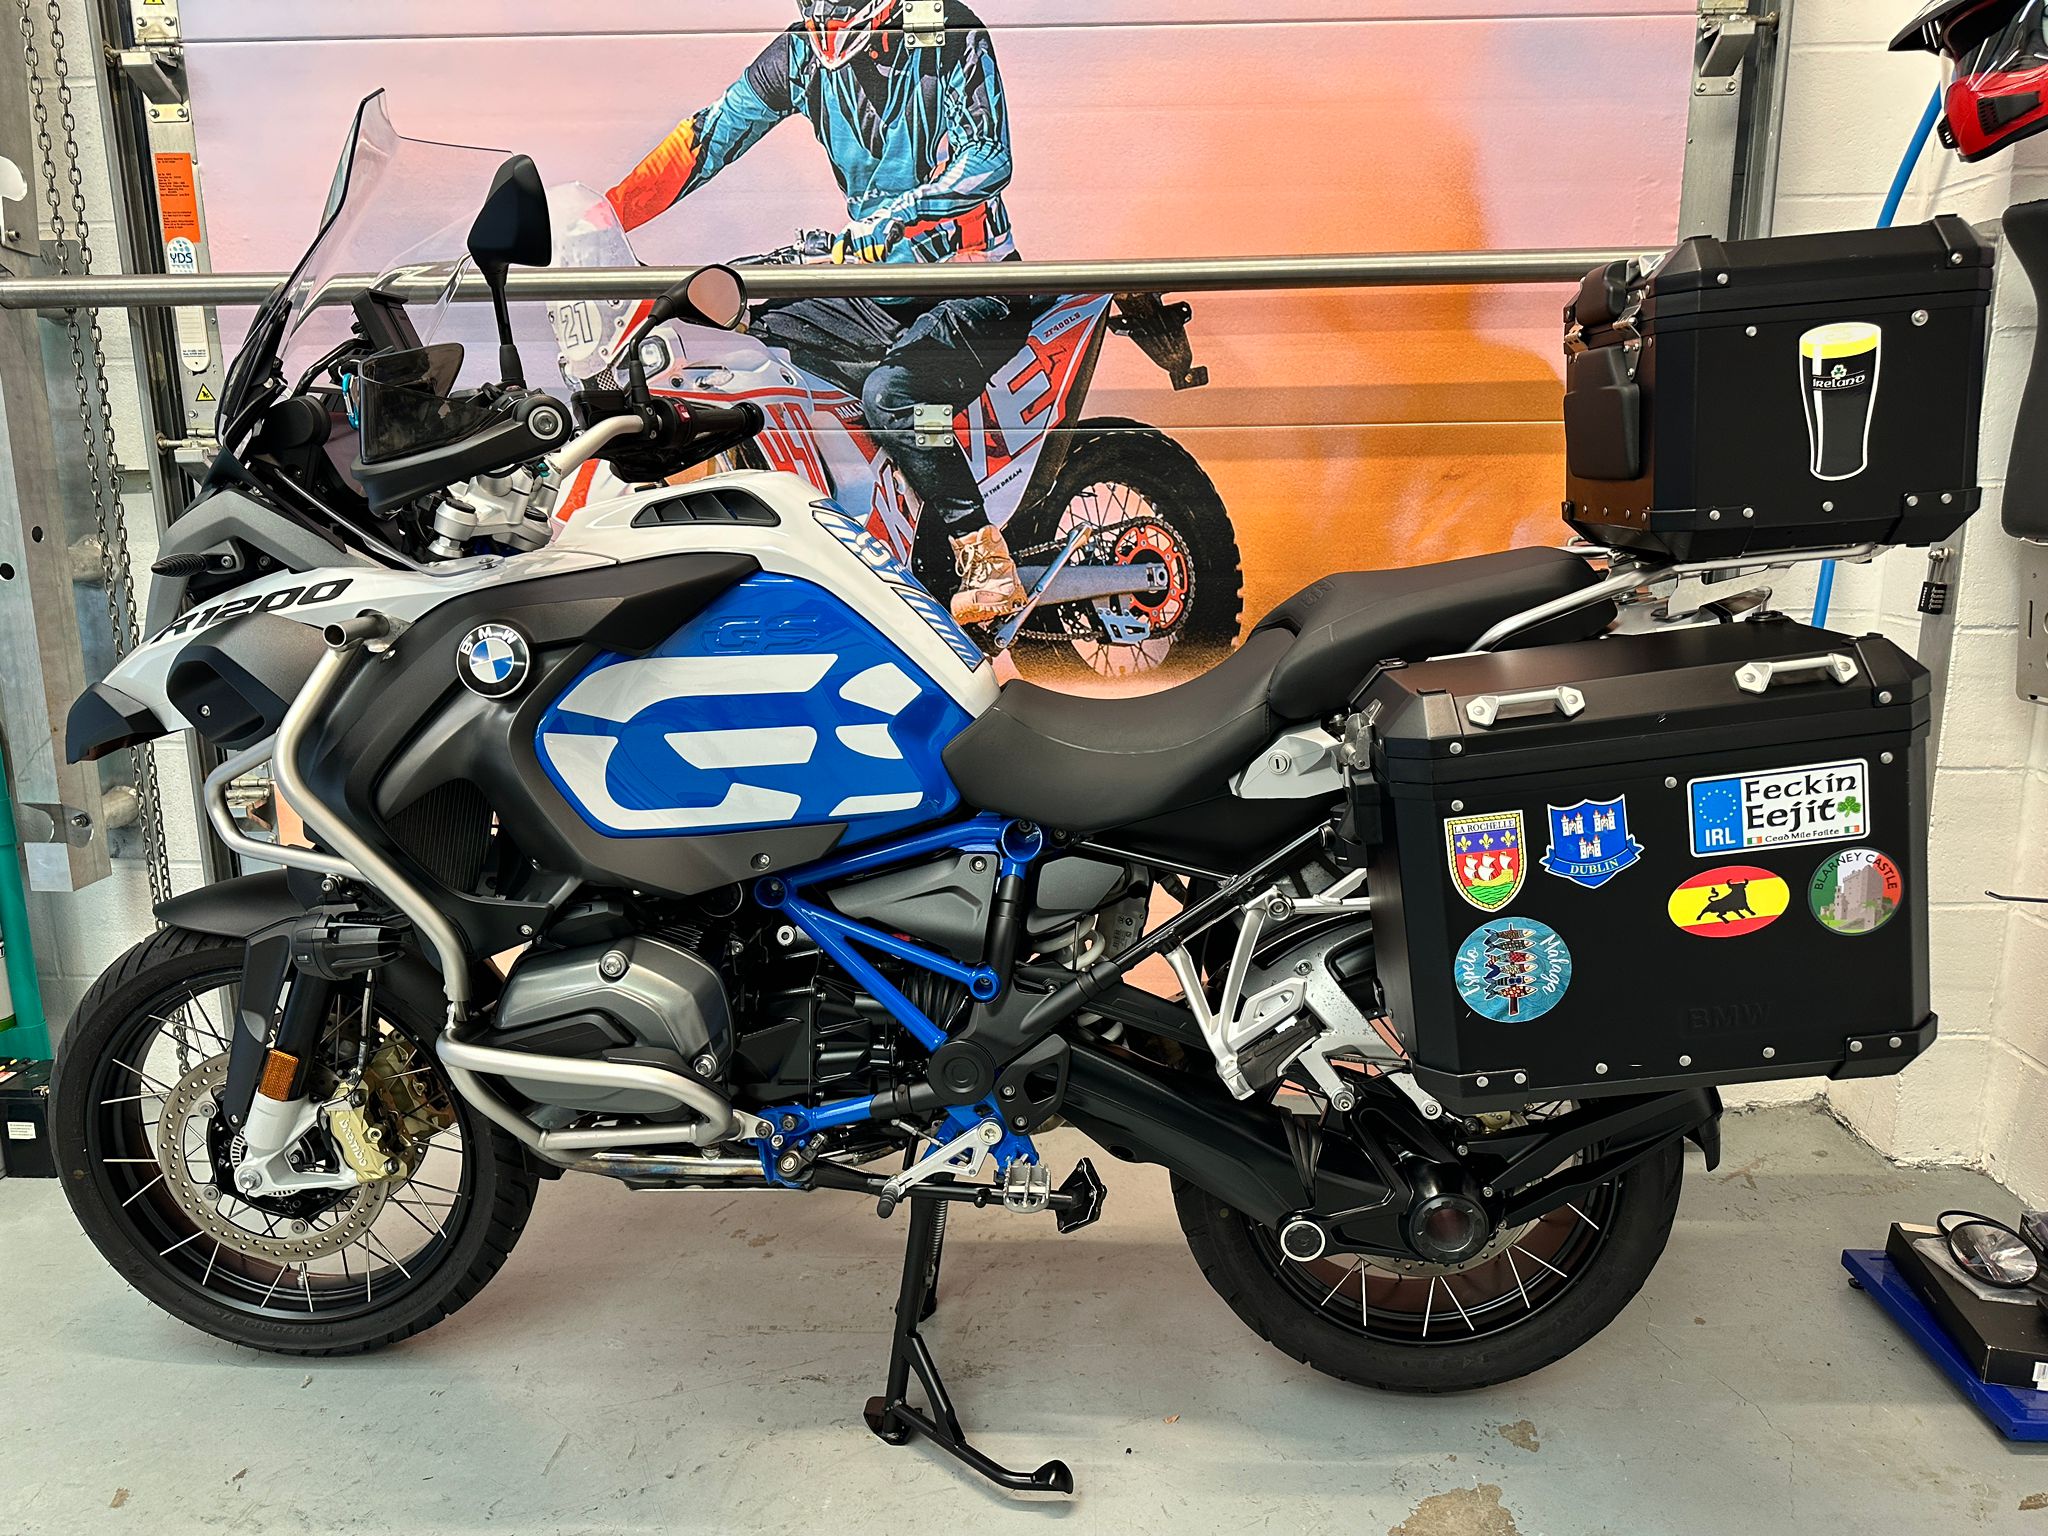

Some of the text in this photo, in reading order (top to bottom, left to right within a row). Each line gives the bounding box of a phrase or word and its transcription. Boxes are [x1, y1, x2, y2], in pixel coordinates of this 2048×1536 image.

[169, 252, 193, 264] YDS
[560, 300, 594, 349] 21
[1000, 468, 1022, 487] DREAM
[149, 578, 354, 645] R1200
[460, 626, 518, 656] BMW
[701, 614, 820, 654] GS
[1745, 773, 1857, 802] Feckin
[1454, 819, 1515, 834] LA ROCHELLE
[1746, 798, 1837, 833] Eejit
[1705, 827, 1736, 847] IRL
[1570, 858, 1619, 875] DUBLIN
[1814, 852, 1898, 890] BLARNEY CASTLE
[1457, 933, 1570, 998] Espeto Málaga
[1687, 1001, 1774, 1031] BMW
[338, 1118, 368, 1168] brembo
